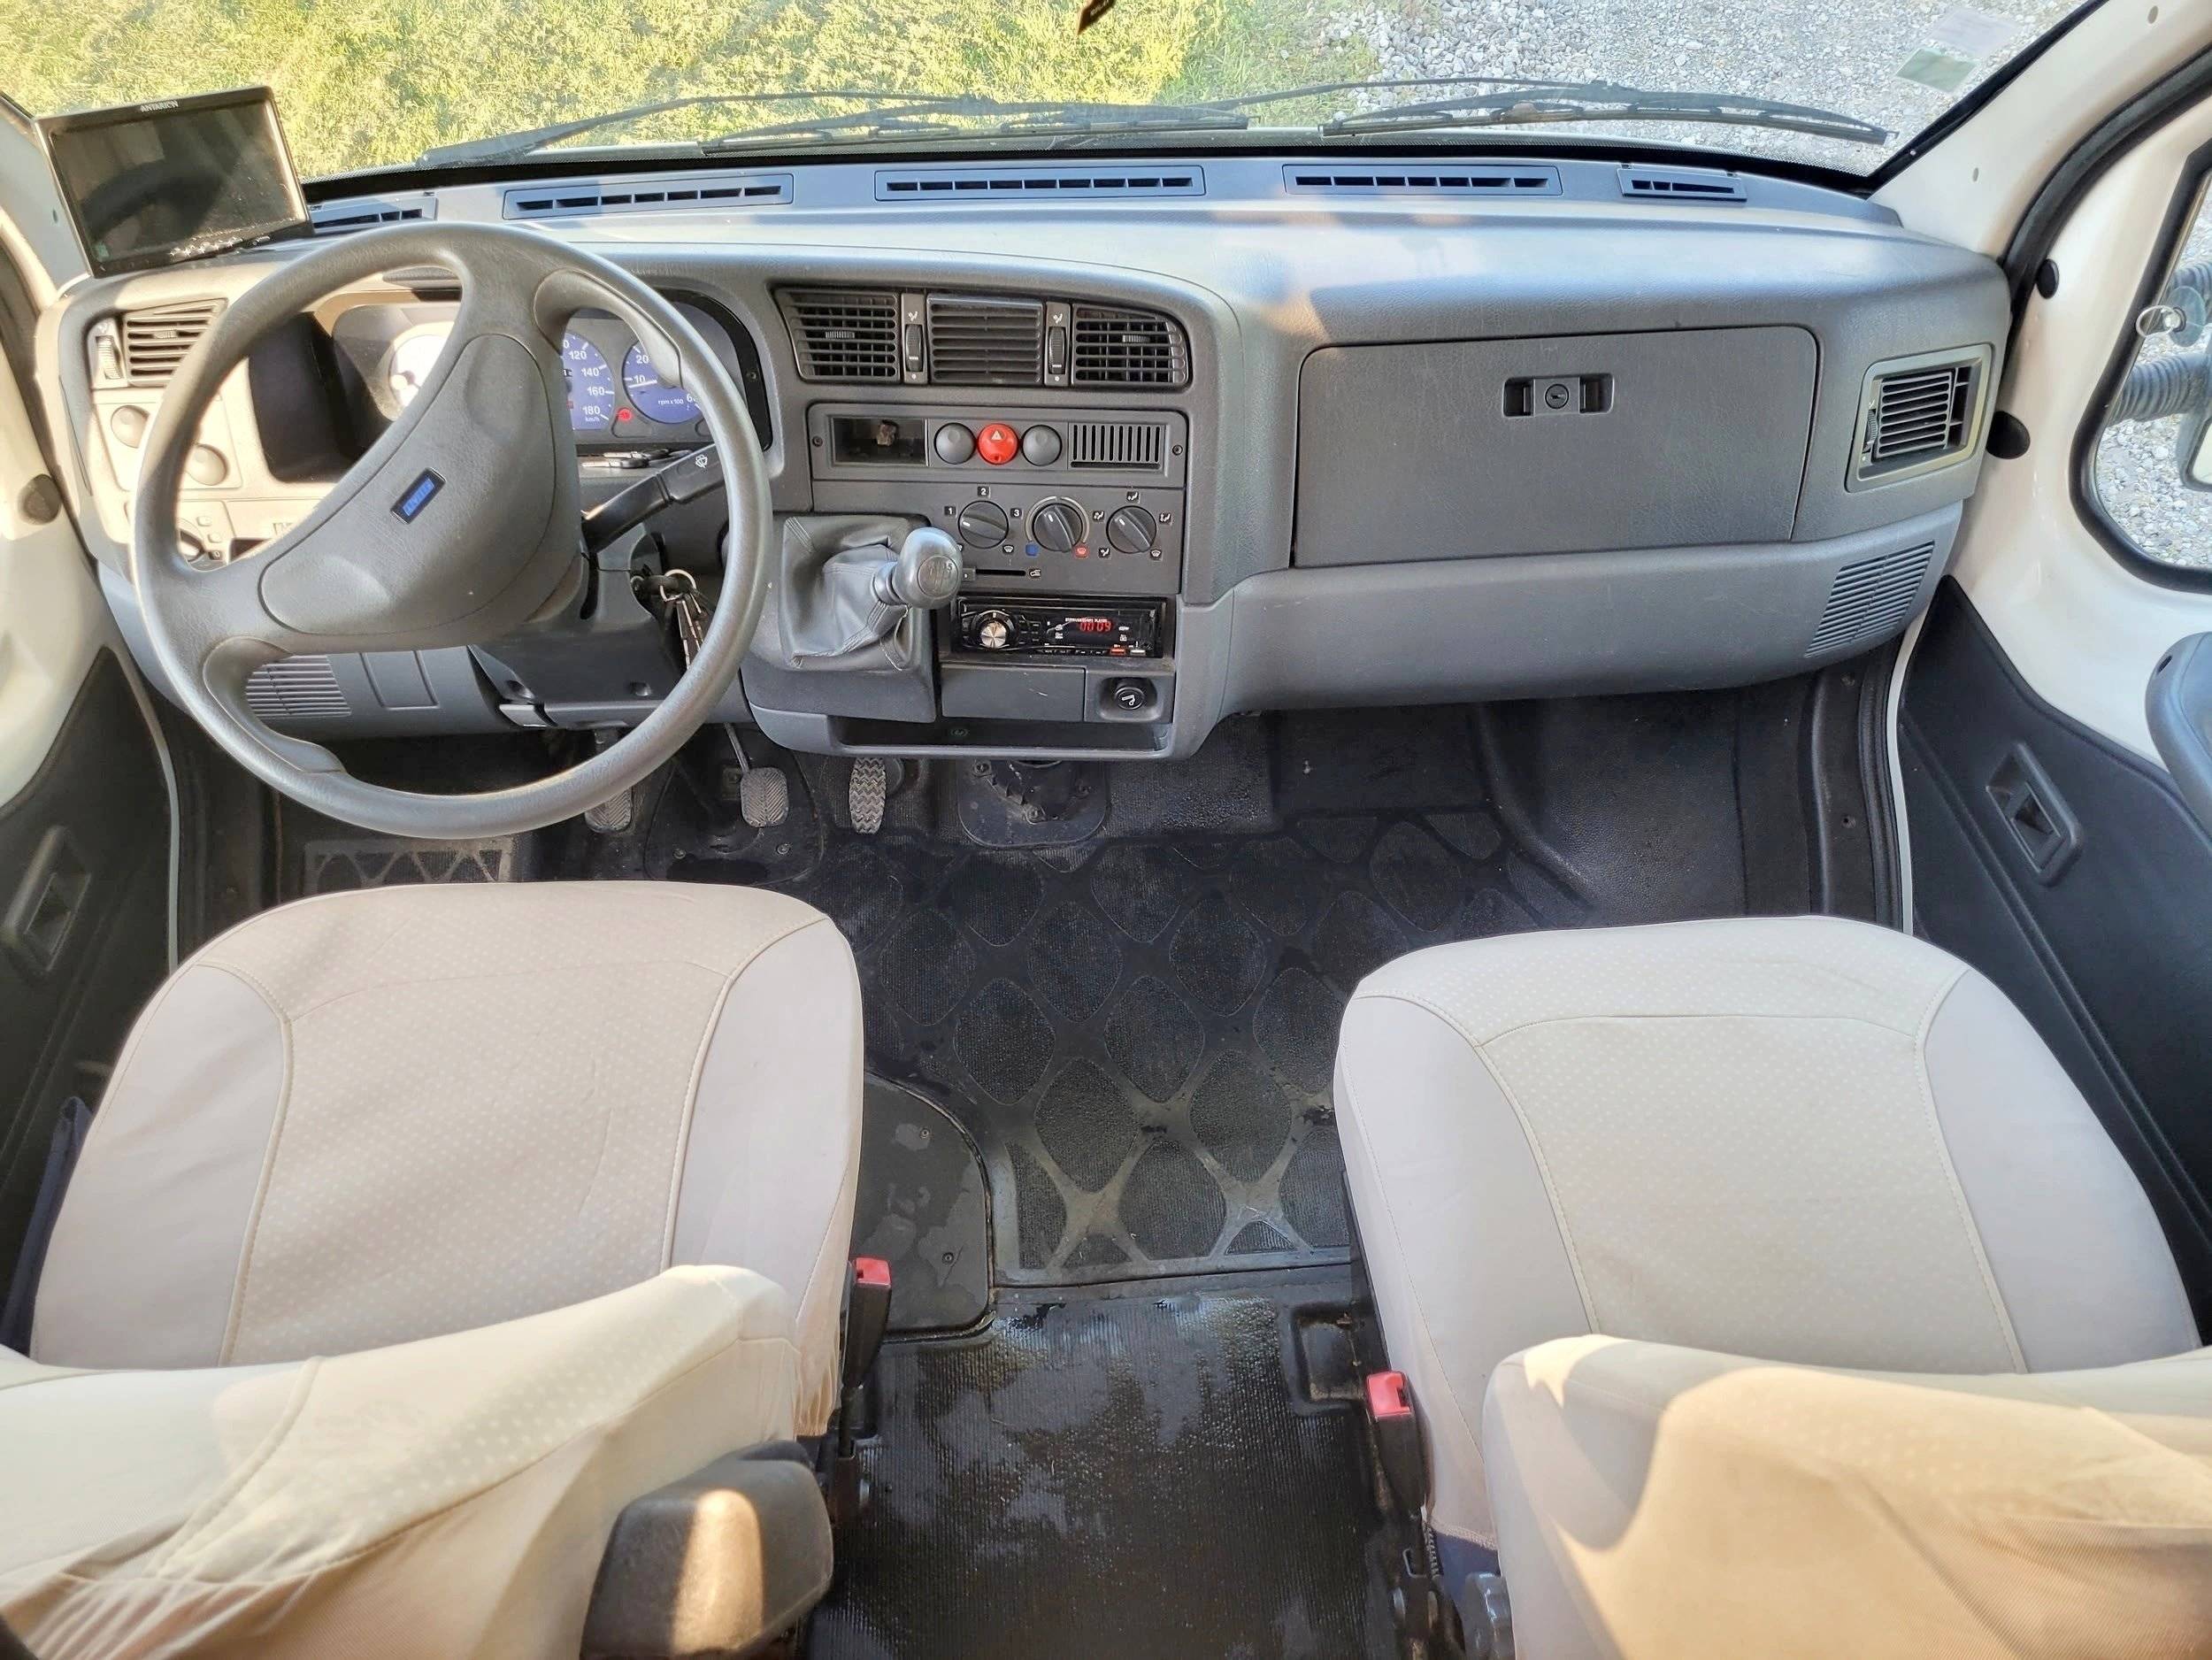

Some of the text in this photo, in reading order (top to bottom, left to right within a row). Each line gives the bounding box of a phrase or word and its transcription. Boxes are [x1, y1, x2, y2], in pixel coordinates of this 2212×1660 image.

[569, 350, 588, 360] 120
[635, 355, 649, 365] 20
[581, 367, 600, 377] 140
[634, 374, 646, 383] 10
[587, 386, 606, 396] 160
[582, 405, 601, 415] 180
